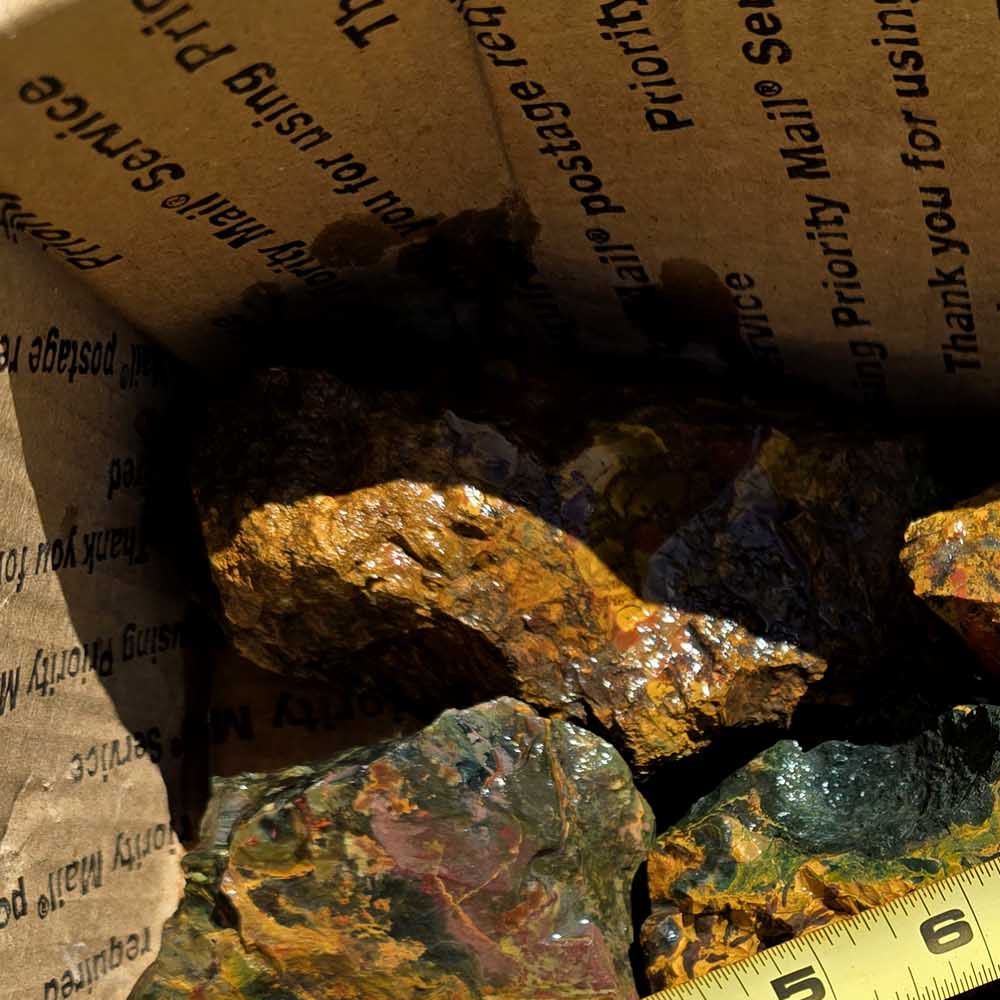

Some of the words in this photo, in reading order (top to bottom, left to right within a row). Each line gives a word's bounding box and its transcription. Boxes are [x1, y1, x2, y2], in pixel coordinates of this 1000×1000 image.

[456, 0, 529, 67] req
[870, 0, 930, 98] usin
[17, 73, 186, 193] Service
[221, 61, 334, 153] using
[754, 79, 832, 181] Mail®
[899, 109, 945, 171] for
[314, 152, 378, 194] for
[508, 79, 627, 216] postage
[917, 186, 971, 257] you
[803, 192, 872, 328] Priority
[27, 325, 118, 384] postage
[928, 265, 982, 374] Thank
[34, 526, 78, 576] you
[26, 637, 115, 699] Priority
[919, 909, 974, 954] 6
